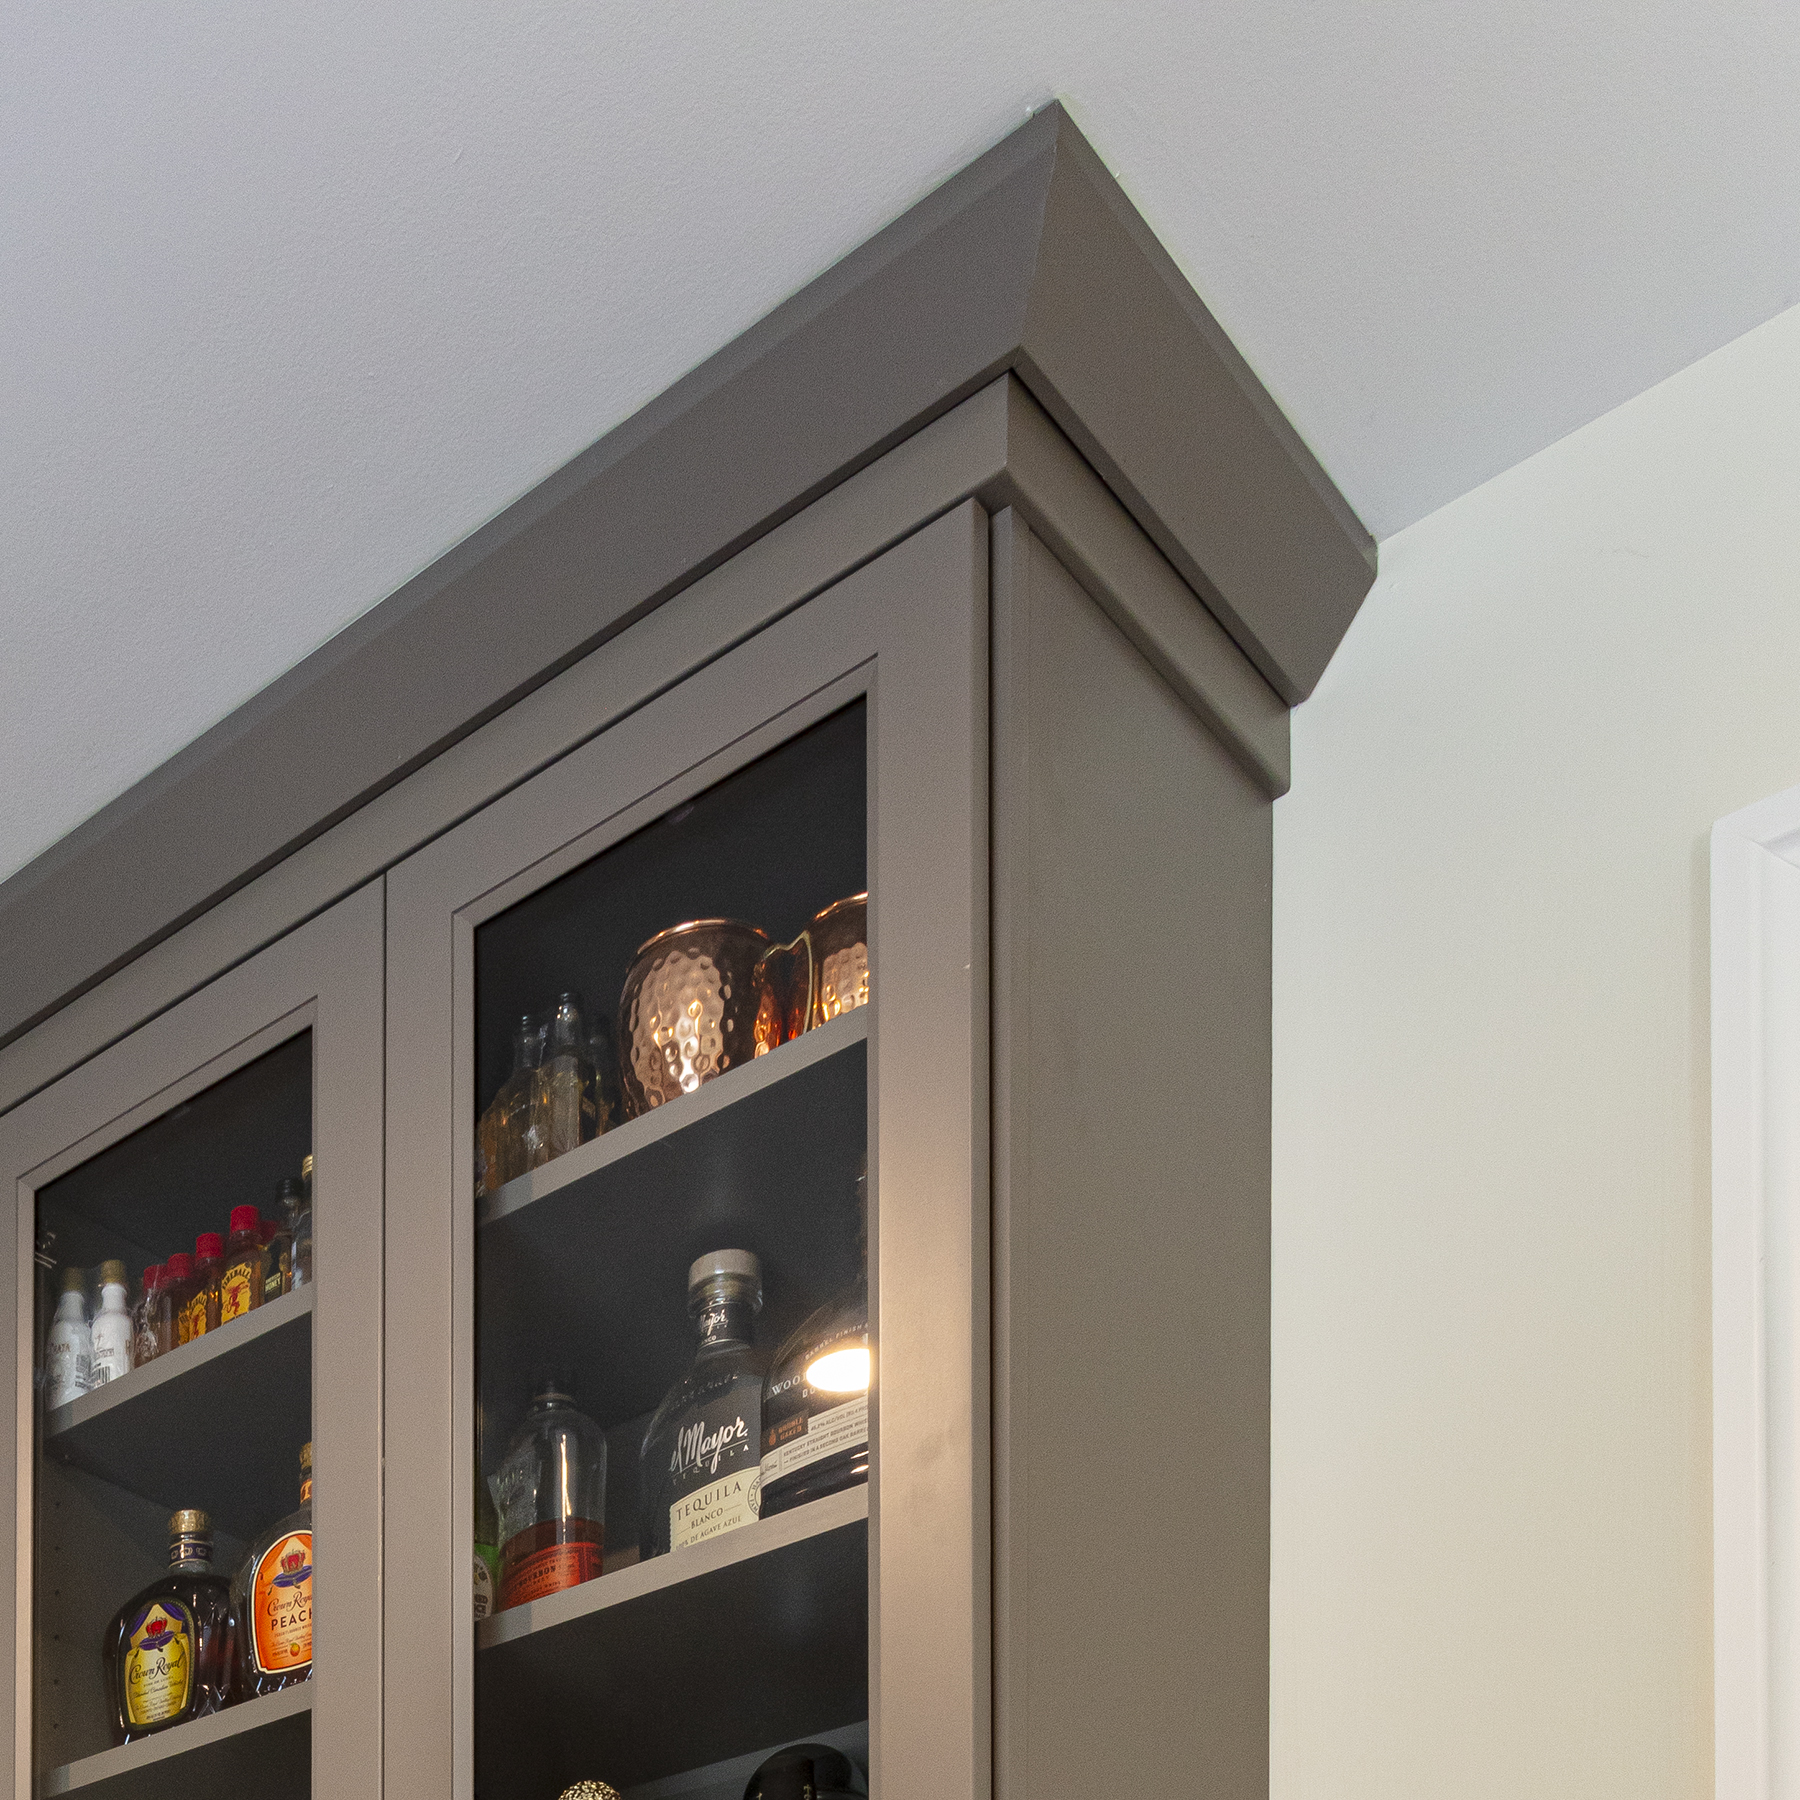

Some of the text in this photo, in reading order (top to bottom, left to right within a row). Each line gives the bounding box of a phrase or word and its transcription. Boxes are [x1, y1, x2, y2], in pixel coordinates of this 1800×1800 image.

[675, 1481, 743, 1522] TEQUILA
[690, 1507, 725, 1531] BLANCO
[129, 1656, 183, 1685] Crown Royal
